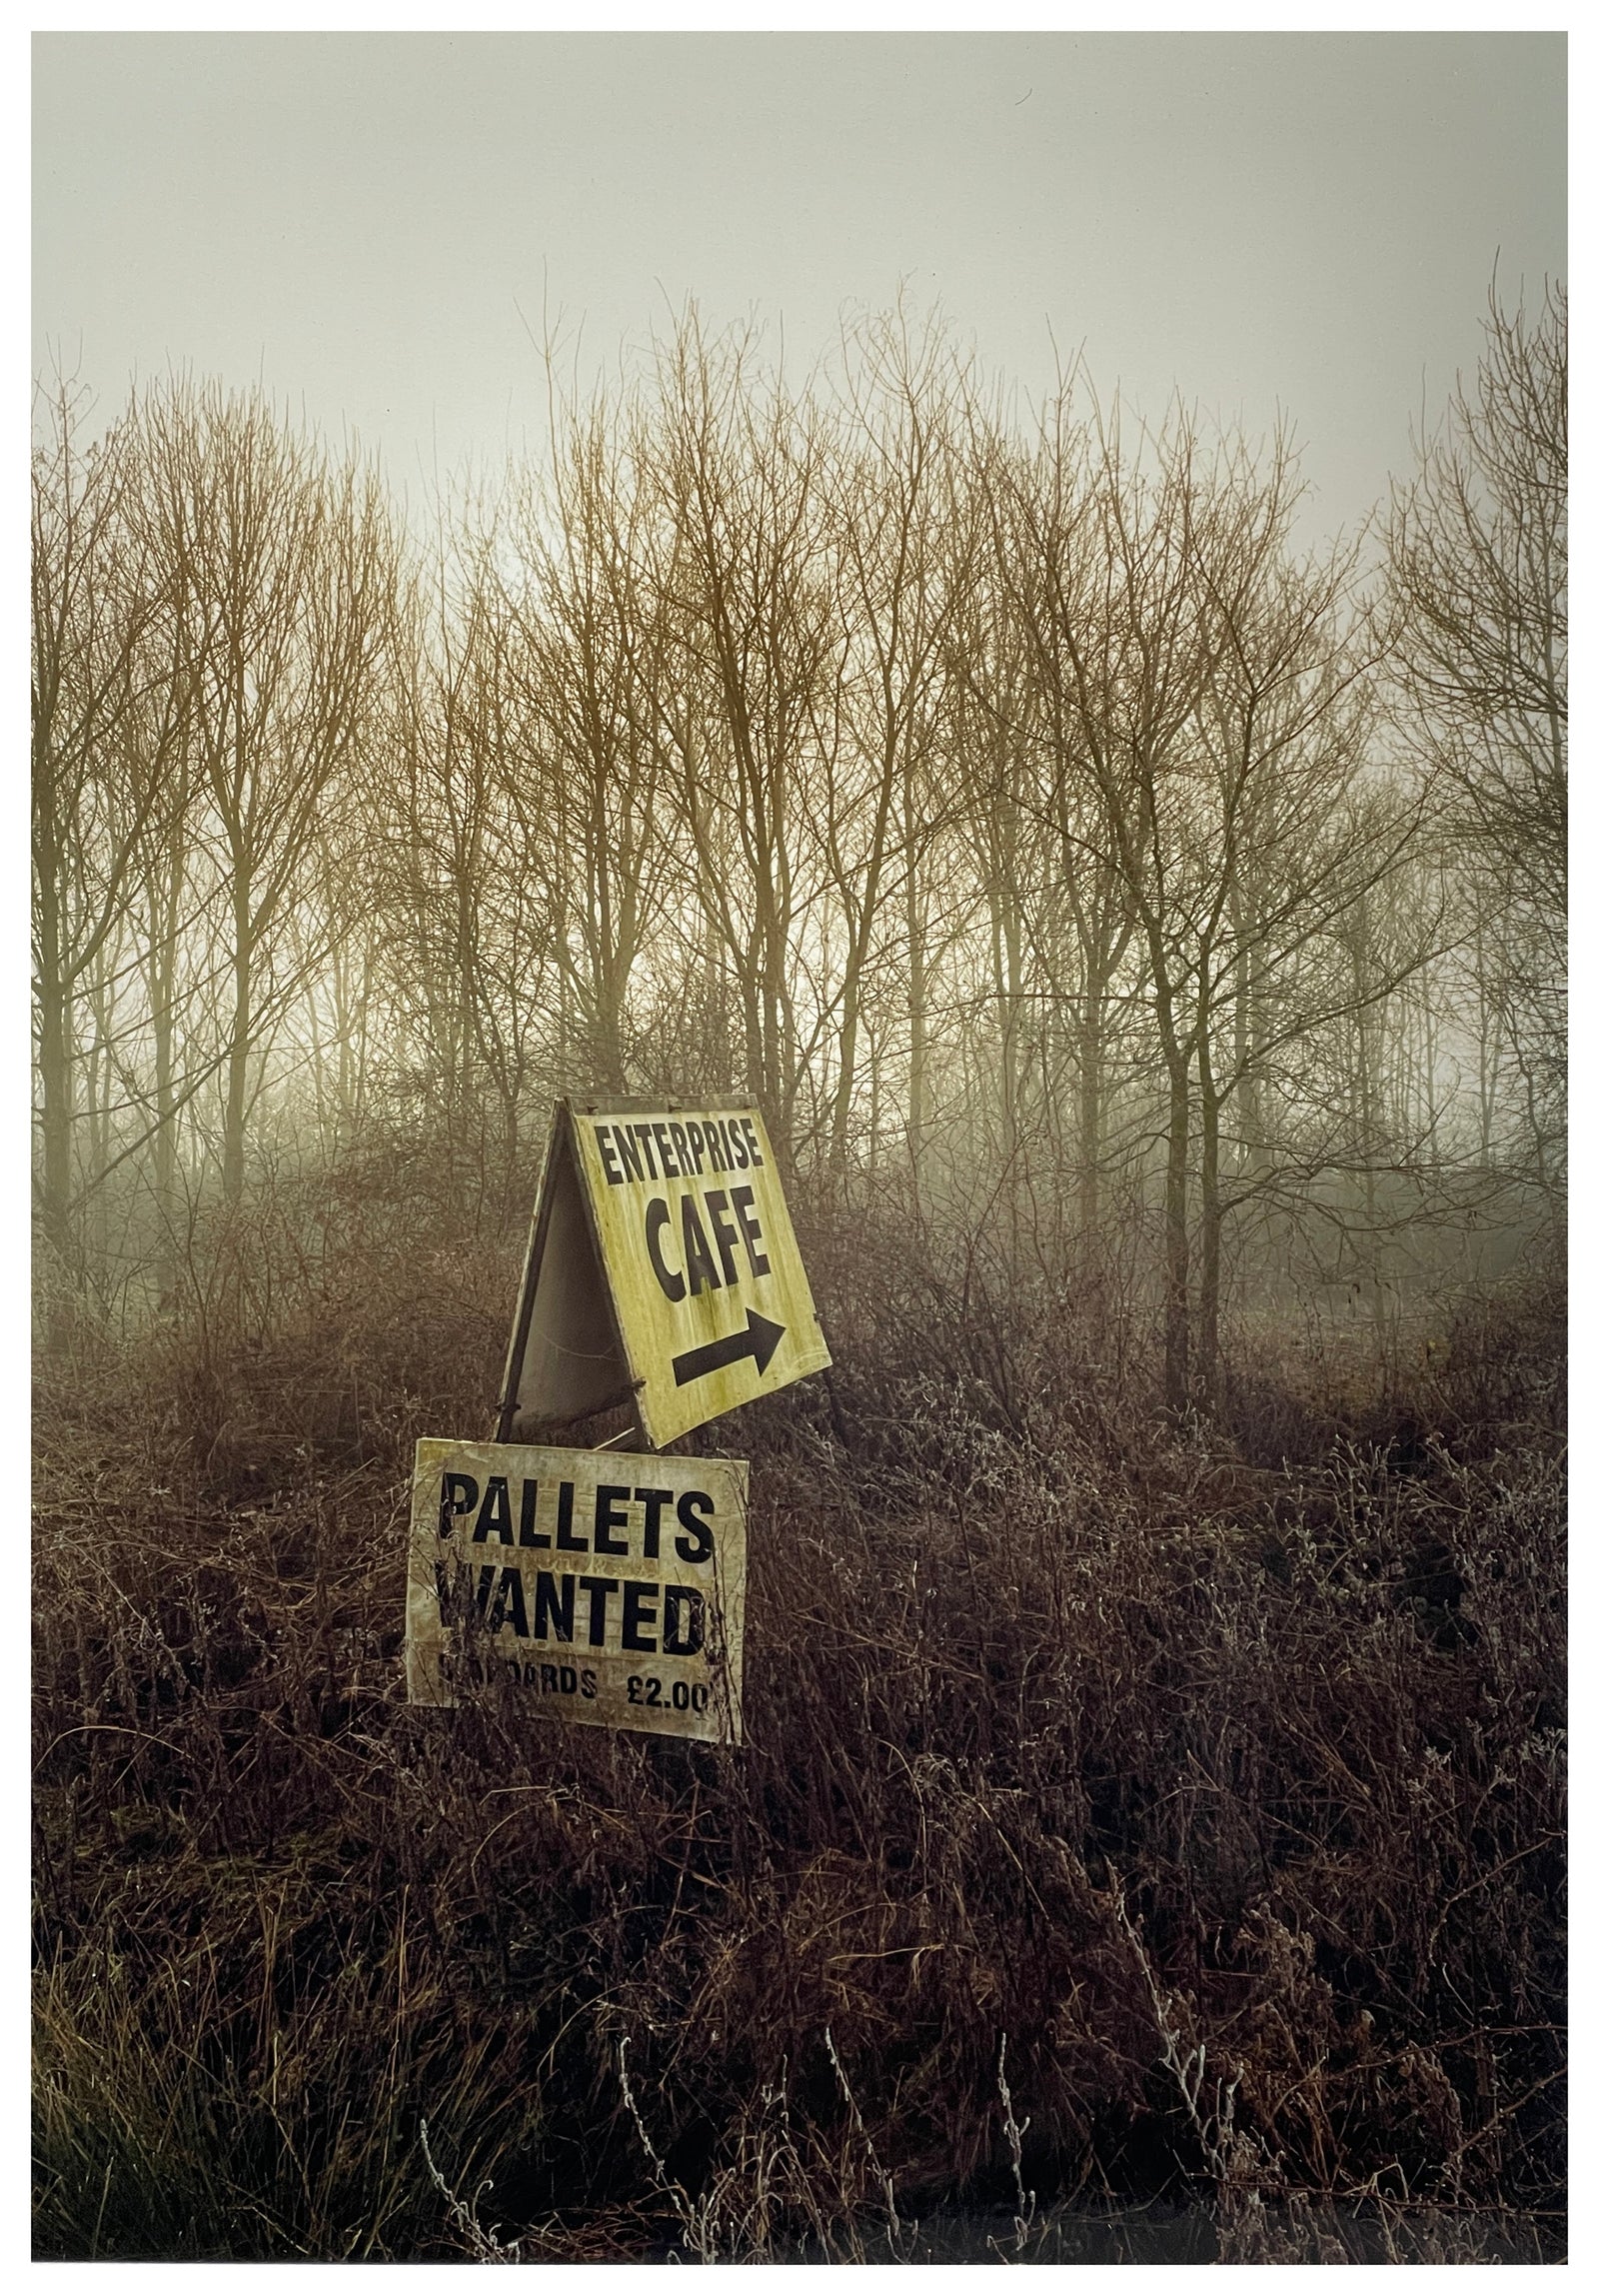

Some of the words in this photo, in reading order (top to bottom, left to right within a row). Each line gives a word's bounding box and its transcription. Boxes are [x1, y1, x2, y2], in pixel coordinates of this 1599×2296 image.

[594, 1118, 764, 1185] ENTERPRISE
[646, 1185, 771, 1302] CAFE
[439, 1472, 716, 1563] PALLETS
[434, 1559, 705, 1656] WANTED
[439, 1653, 598, 1698] SDARDS
[627, 1675, 709, 1713] £2.00
